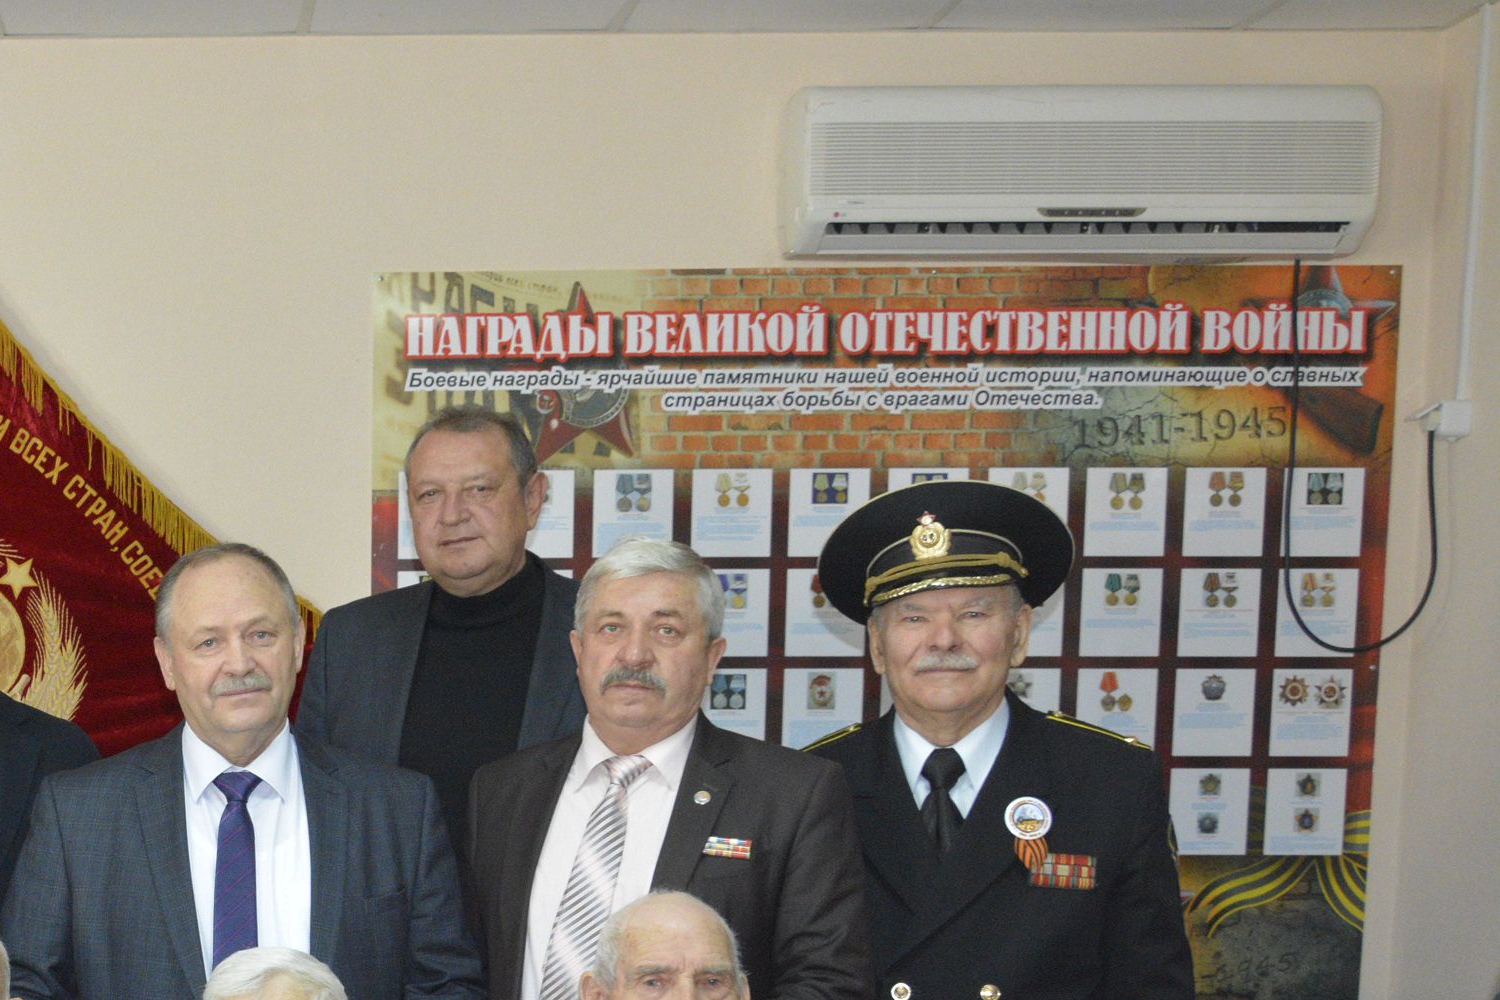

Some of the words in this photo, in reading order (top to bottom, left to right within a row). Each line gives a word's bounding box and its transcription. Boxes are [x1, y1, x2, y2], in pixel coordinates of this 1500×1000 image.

[405, 314, 612, 361] НАГРАДЫ
[624, 304, 828, 357] ВЕЛИКОЙ
[839, 303, 1191, 355] ОТЕЧЕСТВЕННОЙ
[1201, 303, 1367, 354] ВОЙНЫ
[408, 370, 488, 388] Боевые
[491, 370, 579, 392] награды
[596, 368, 698, 389] ярчайшие
[701, 369, 818, 386] памятники
[823, 367, 891, 385] нашей
[894, 366, 980, 384] военной
[985, 368, 1082, 388] истории,
[1087, 368, 1248, 387] напоминающие
[1251, 369, 1265, 383] о
[1270, 368, 1360, 384] славных
[664, 392, 776, 411] страницах
[782, 390, 861, 411] борьбы
[866, 393, 878, 407] с
[883, 392, 968, 411] врагами
[974, 388, 1100, 407] Отечества.
[1073, 404, 1288, 448] 1941-1945
[8, 427, 70, 486] ВСЕХ
[62, 474, 130, 553] СТРАН,
